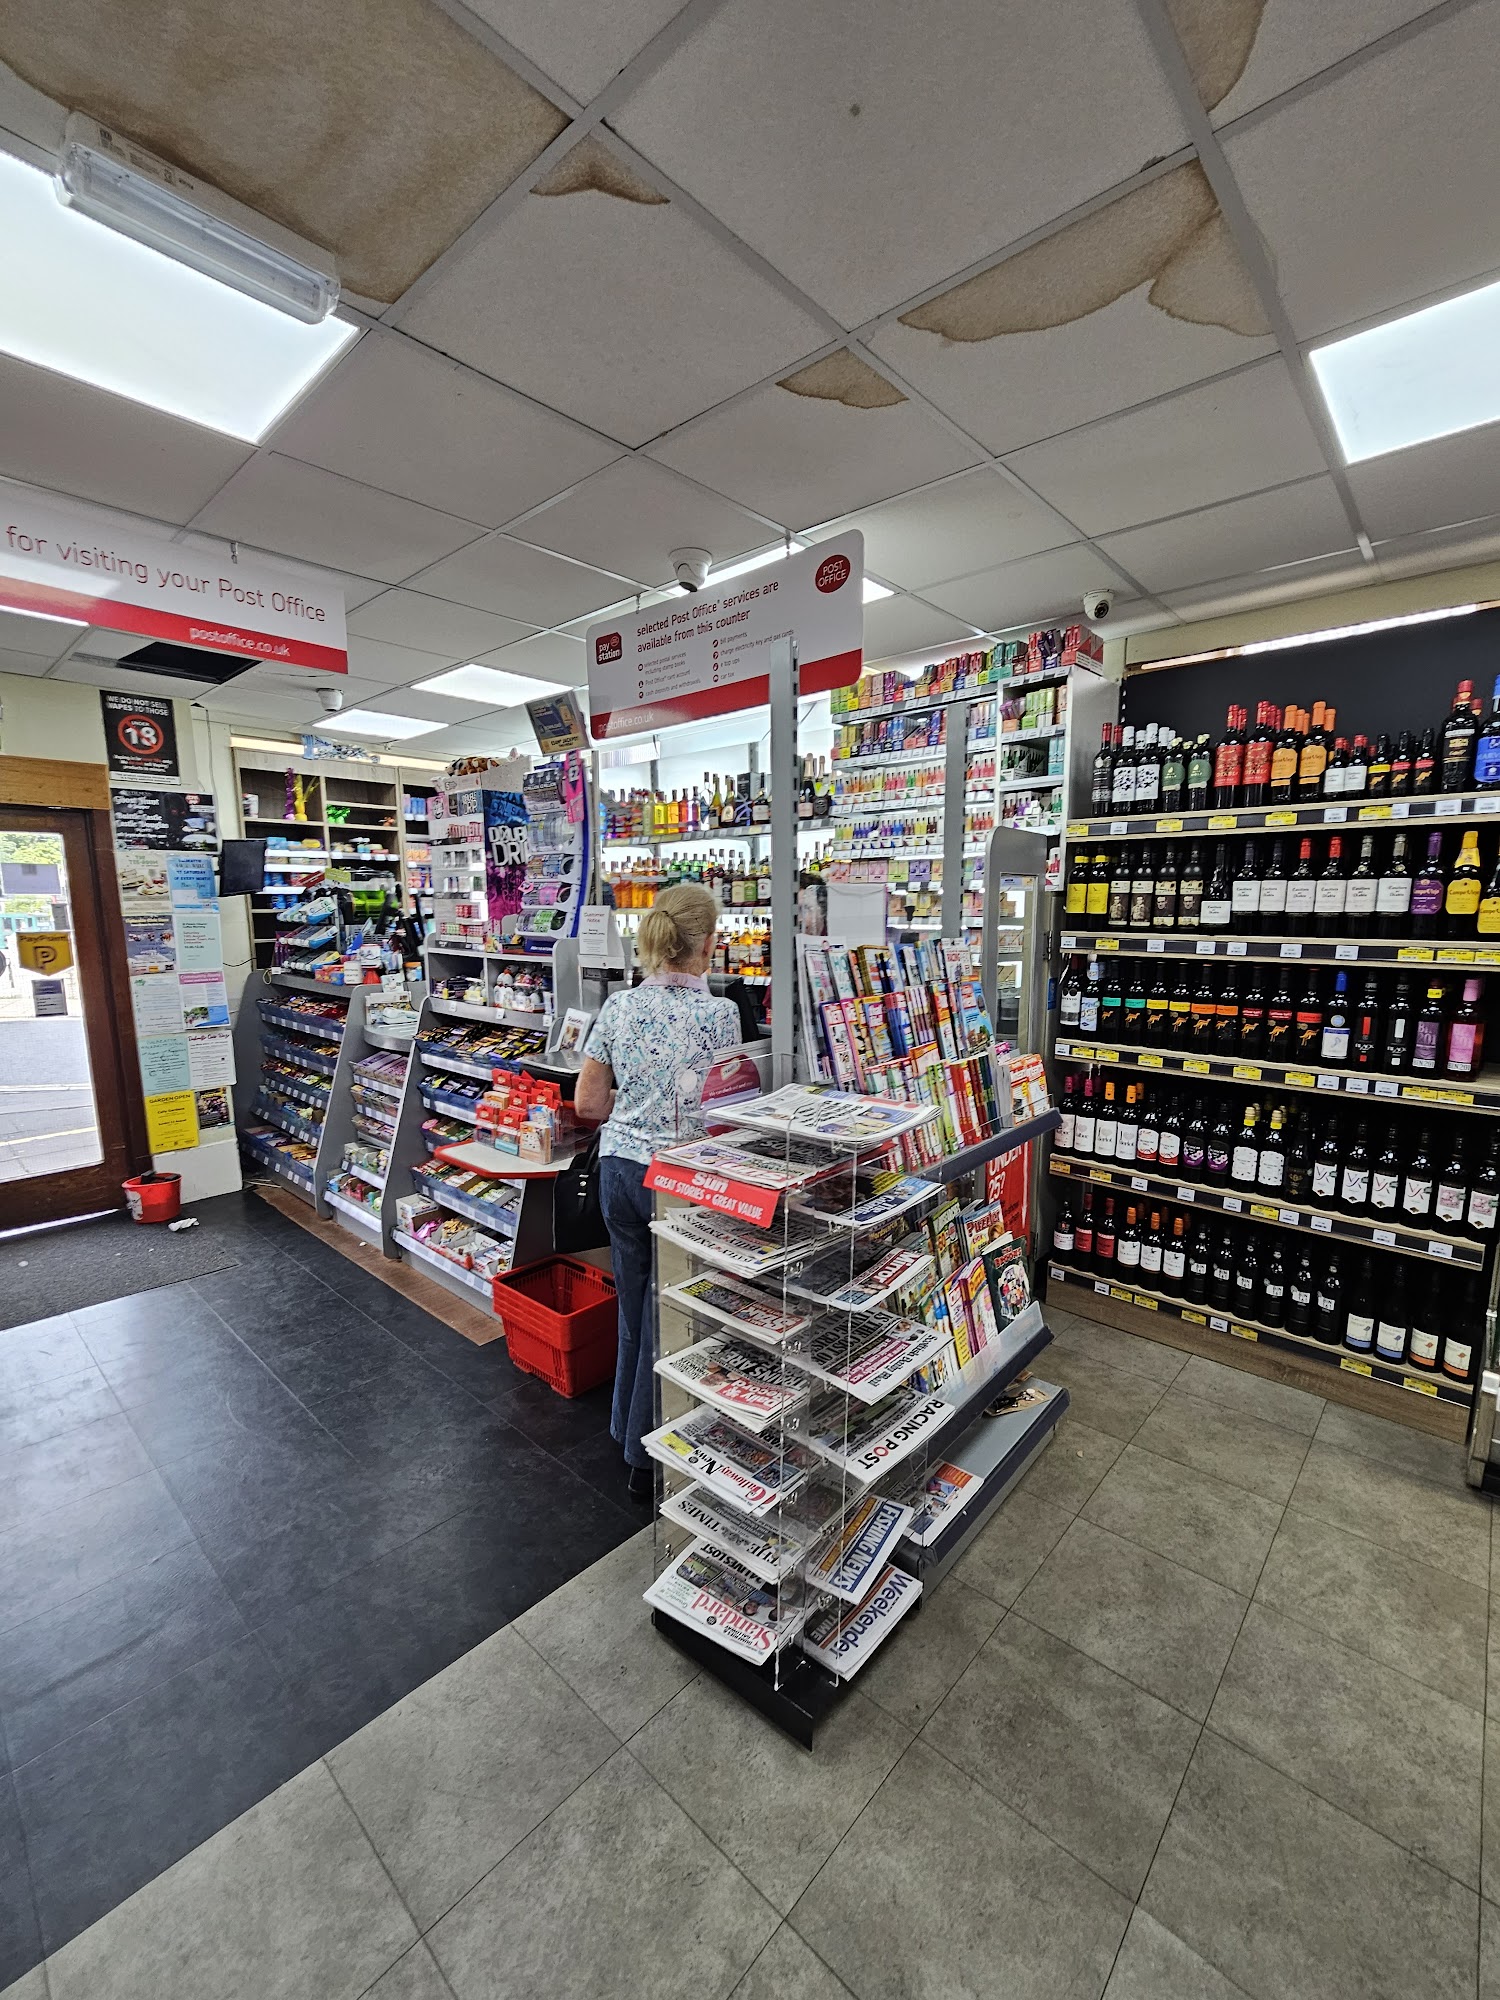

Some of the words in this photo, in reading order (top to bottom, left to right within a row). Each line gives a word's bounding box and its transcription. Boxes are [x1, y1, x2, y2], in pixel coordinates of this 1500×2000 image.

[7, 525, 47, 554] for
[56, 542, 148, 583] visiting
[156, 568, 209, 594] your
[218, 578, 264, 609] Post
[271, 592, 326, 622] Office
[817, 569, 847, 587] OFFICE
[823, 560, 844, 575] POST
[636, 617, 669, 636] selected
[671, 611, 690, 626] Post
[722, 588, 760, 608] services
[762, 581, 779, 595] are
[189, 627, 290, 657] postoffice.co.uk
[637, 634, 672, 652] available
[674, 628, 695, 641] from
[697, 620, 713, 635] this
[716, 609, 751, 629] counter
[727, 632, 748, 643] payments
[598, 648, 621, 661] station
[599, 643, 610, 651] pay
[107, 703, 133, 711] VAPES
[145, 707, 169, 716] THOSE
[597, 711, 654, 734] postoffice.co.uk
[124, 726, 157, 747] 18
[691, 1172, 730, 1194] Sun
[988, 1171, 1006, 1204] 25?
[653, 1174, 676, 1192] GREAT
[676, 1180, 705, 1200] STORIES
[711, 1193, 737, 1213] GREAT
[737, 1201, 764, 1220] VALUE
[874, 1250, 919, 1284] Mirror
[746, 1306, 796, 1331] STAR
[851, 1319, 882, 1341] THE
[875, 1312, 891, 1324] IS
[826, 1334, 861, 1358] COST
[907, 1333, 937, 1359] Scottish
[720, 1348, 757, 1371] ARE
[885, 1355, 912, 1374] Daily
[731, 1379, 789, 1402] Record
[752, 1365, 811, 1392] TRAINS
[868, 1371, 891, 1388] Mail
[742, 1389, 775, 1411] Daily
[883, 1420, 894, 1430] THE
[893, 1414, 902, 1422] ON
[893, 1398, 945, 1443] RACING
[866, 1427, 885, 1444] RACING
[693, 1447, 723, 1476] News
[858, 1438, 899, 1471] POST
[720, 1466, 767, 1502] Galloway
[677, 1499, 721, 1533] TIMES
[859, 1505, 900, 1556] FISHING
[700, 1542, 727, 1560] LOST
[746, 1542, 776, 1567] THE
[833, 1548, 873, 1592] NEWS
[690, 1592, 777, 1653] Standard
[810, 1614, 836, 1641] TIME
[829, 1573, 913, 1659] Weekender
